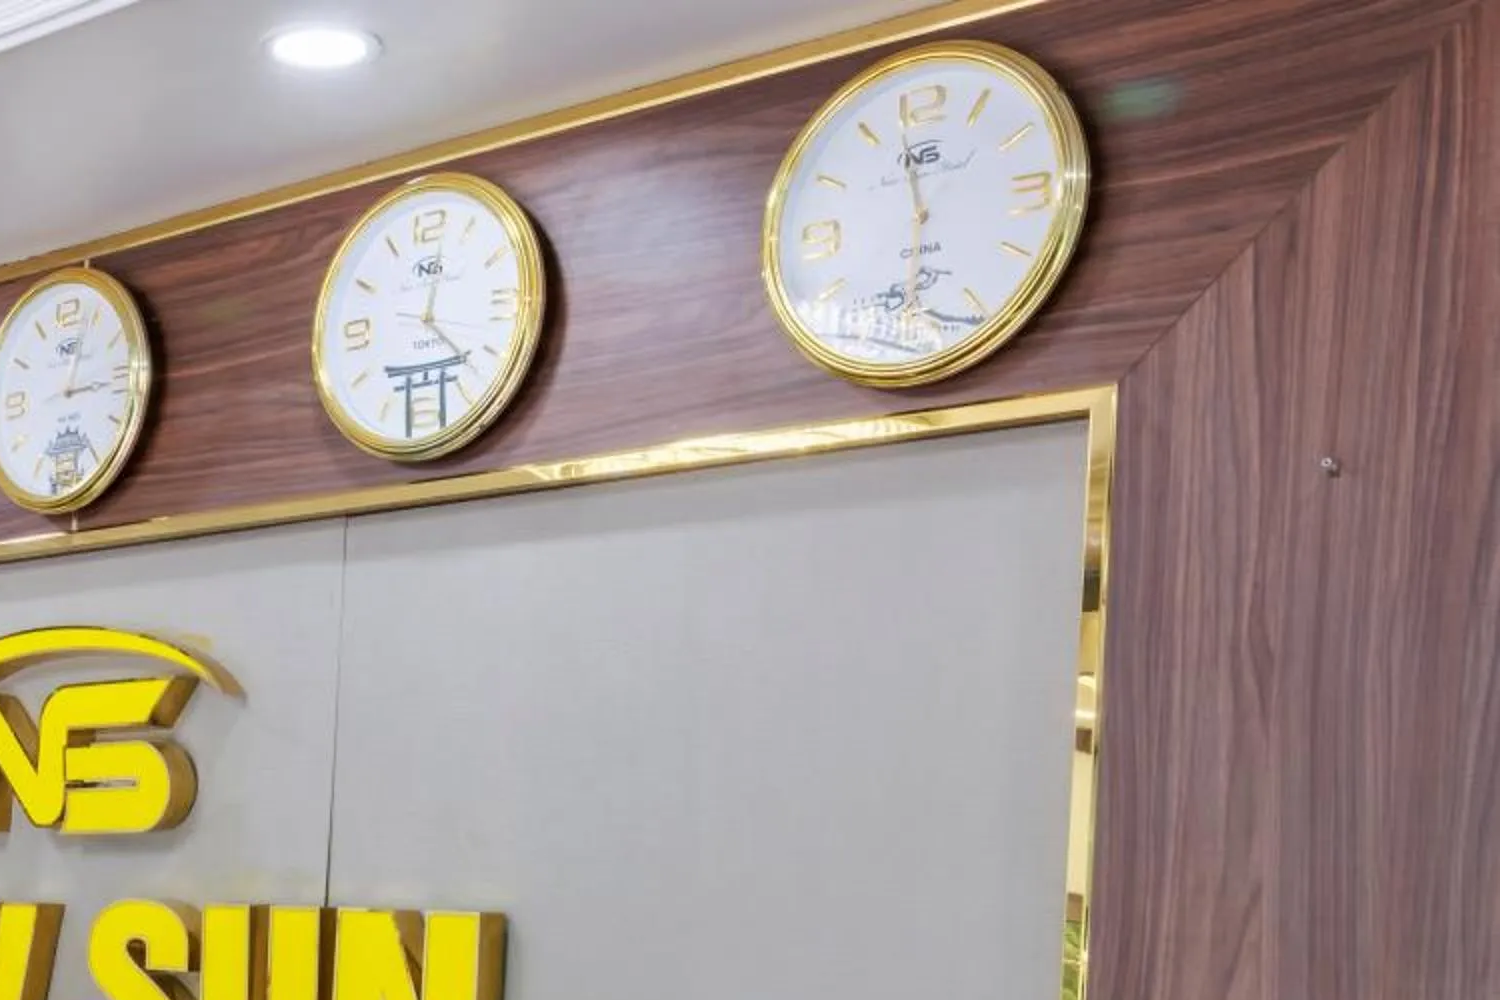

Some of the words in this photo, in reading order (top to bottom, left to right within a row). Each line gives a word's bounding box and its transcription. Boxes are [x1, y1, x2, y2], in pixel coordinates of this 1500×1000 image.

[899, 85, 947, 128] 12
[1011, 171, 1053, 217] 3
[413, 208, 447, 245] 12
[801, 219, 842, 260] 9
[900, 241, 942, 259] CINA
[56, 297, 81, 328] 12
[343, 318, 371, 352] 9
[5, 390, 26, 421] 9
